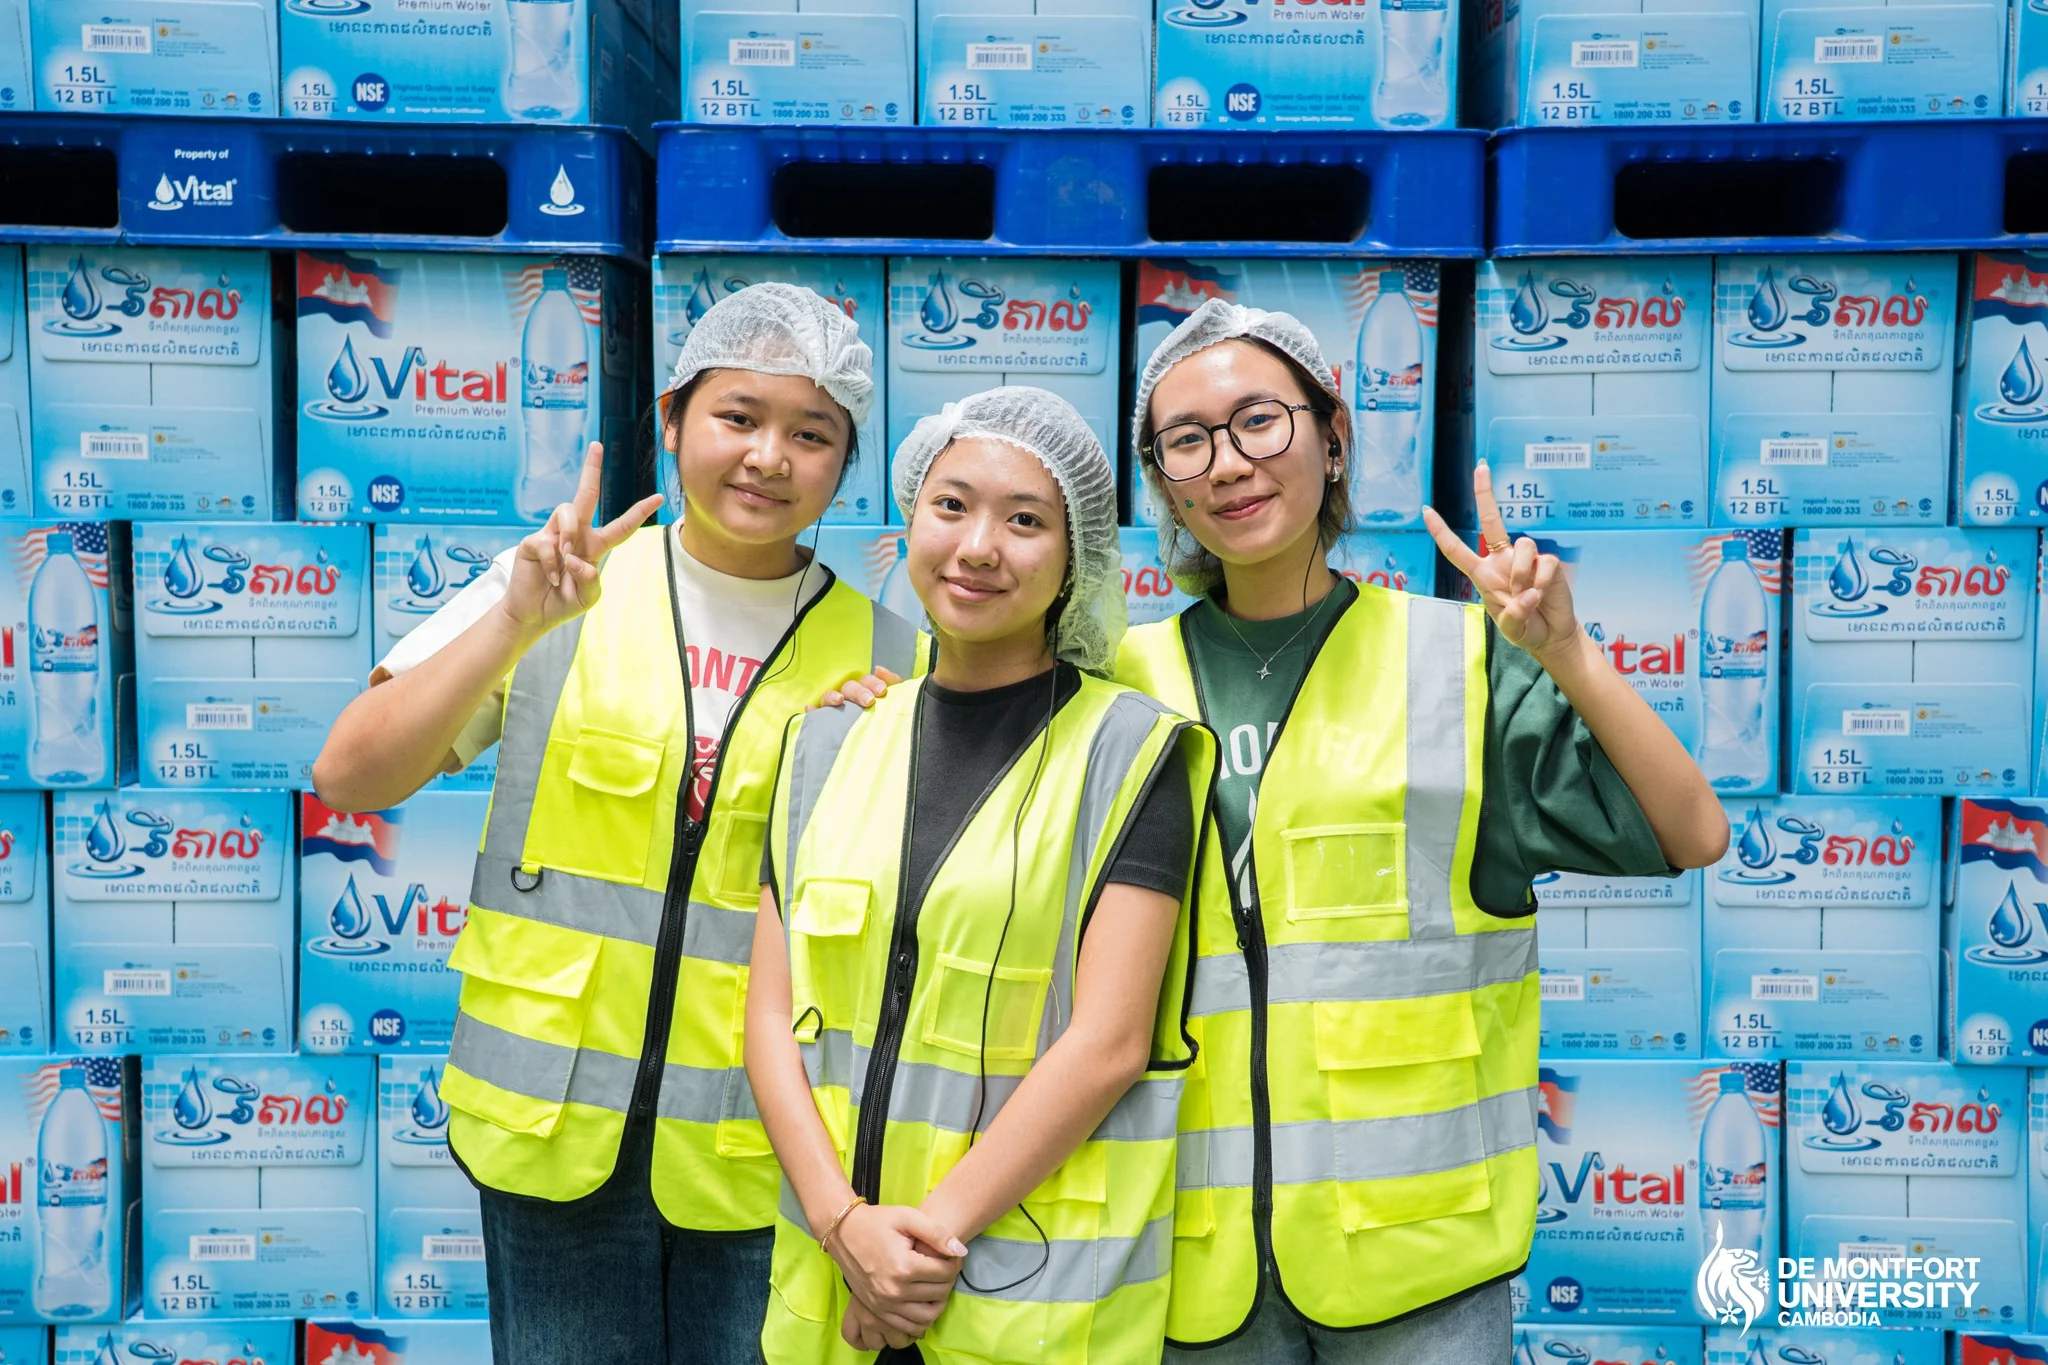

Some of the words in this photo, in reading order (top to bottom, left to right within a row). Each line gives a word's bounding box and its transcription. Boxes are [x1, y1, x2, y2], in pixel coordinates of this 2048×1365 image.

[1274, 9, 1327, 20] Premium
[1331, 10, 1364, 20] Water
[66, 66, 105, 83] 1.5L
[302, 84, 330, 96] 1.5L
[712, 80, 750, 96] 1.5L
[950, 85, 986, 100] 1.5L
[1553, 83, 1590, 98] 1.5L
[1796, 78, 1834, 94] 1.5L
[55, 90, 74, 103] 12
[82, 90, 116, 104] BTL
[1176, 95, 1204, 107] 1.5L
[294, 101, 308, 111] 12
[313, 99, 340, 113] BTL
[702, 103, 719, 116] 12
[727, 104, 760, 116] BTL
[1542, 106, 1559, 119] 12
[1567, 106, 1600, 119] BTL
[1784, 103, 1801, 116] 12
[1809, 102, 1842, 115] BTL
[2028, 102, 2041, 111] 12
[939, 108, 956, 120] 12
[964, 108, 996, 120] BTL
[1168, 112, 1182, 122] 12
[1186, 111, 1212, 124] BTL
[175, 149, 217, 160] Property
[219, 150, 228, 158] of
[173, 176, 232, 200] Vital
[370, 347, 507, 402] Vital
[416, 404, 469, 415] Premium
[472, 406, 506, 416] Water
[64, 472, 102, 488] 1.5L
[318, 485, 346, 497] 1.5L
[1508, 484, 1544, 498] 1.5L
[1742, 480, 1779, 494] 1.5L
[54, 495, 71, 507] 12
[80, 495, 112, 508] BTL
[1985, 489, 2013, 501] 1.5L
[310, 502, 323, 511] 12
[329, 501, 355, 513] BTL
[1522, 506, 1554, 518] BTL
[1568, 510, 1588, 518] 1800
[1590, 510, 1606, 518] 200
[1609, 509, 1624, 517] 333
[1730, 502, 1748, 514] 12
[1756, 502, 1788, 514] BTL
[1802, 506, 1824, 514] 1800
[1826, 506, 1842, 515] 200
[1844, 506, 1860, 514] 333
[1976, 506, 1989, 516] 12
[1995, 506, 2020, 518] BTL
[1585, 622, 1686, 675] tal
[1650, 679, 1684, 688] Water
[170, 744, 208, 758] 1.5L
[1824, 750, 1862, 764] 1.5L
[160, 766, 177, 778] 12
[185, 766, 218, 778] BTL
[1813, 772, 1830, 784] 12
[1838, 772, 1871, 784] BTL
[1886, 776, 1906, 784] 1800
[1909, 776, 1925, 784] 200
[1928, 776, 1944, 784] 333
[372, 884, 469, 937] Vit
[87, 1009, 124, 1024] 1.5L
[1734, 1014, 1771, 1029] 1.5L
[320, 1020, 348, 1031] 1.5L
[76, 1032, 93, 1044] 12
[101, 1031, 134, 1044] BTL
[1978, 1029, 2006, 1040] 1.5L
[312, 1036, 324, 1045] 12
[330, 1036, 355, 1047] BTL
[1723, 1036, 1740, 1048] 12
[1748, 1036, 1781, 1048] BTL
[1969, 1046, 1982, 1054] 12
[1988, 1046, 2012, 1056] BTL
[1548, 1152, 1684, 1204] Vital
[1594, 1207, 1647, 1218] Premium
[1650, 1209, 1684, 1218] Water
[172, 1275, 209, 1290] 1.5L
[406, 1274, 442, 1289] 1.5L
[162, 1298, 179, 1310] 12
[187, 1297, 219, 1310] BTL
[394, 1296, 412, 1308] 12
[420, 1296, 452, 1309] BTL
